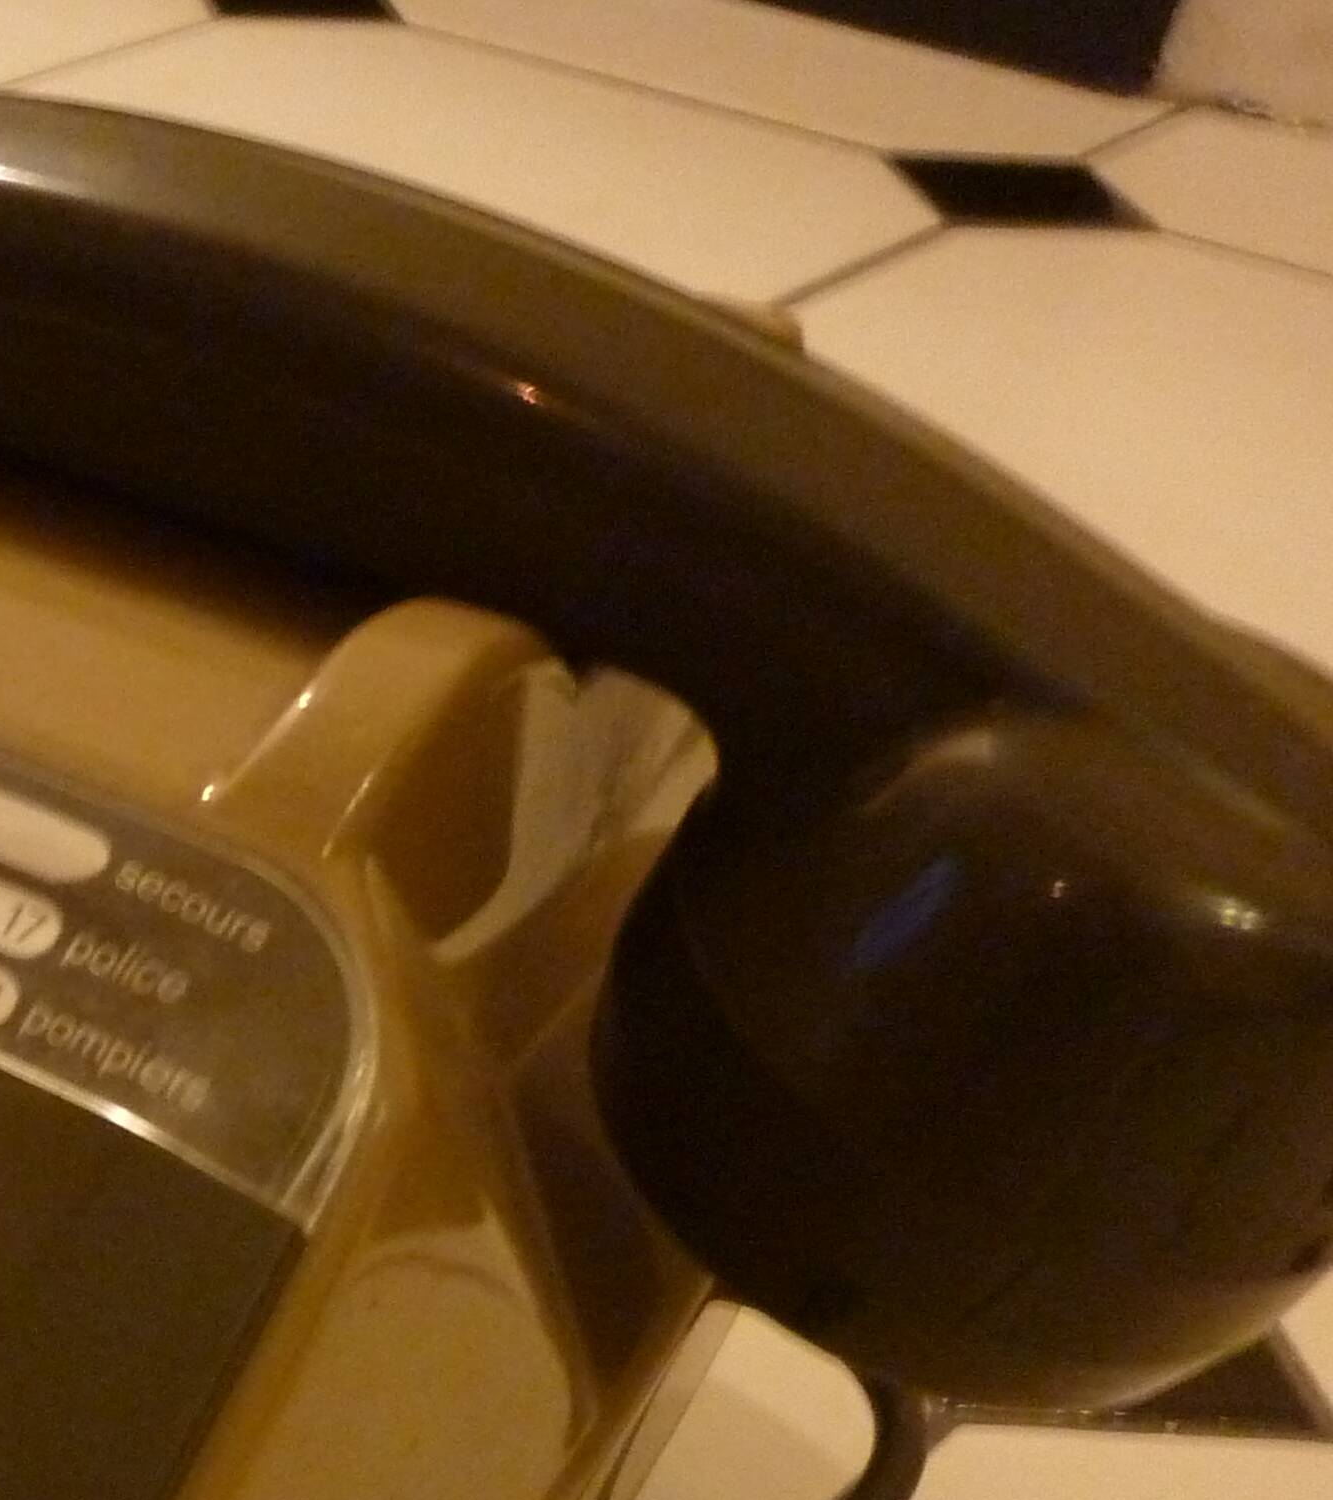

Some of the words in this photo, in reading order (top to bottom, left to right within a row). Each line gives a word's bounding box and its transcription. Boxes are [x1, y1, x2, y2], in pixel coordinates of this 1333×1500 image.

[4, 902, 48, 943] 17
[60, 927, 190, 1004] police
[115, 860, 271, 952] secours
[17, 1001, 212, 1112] pompiers
